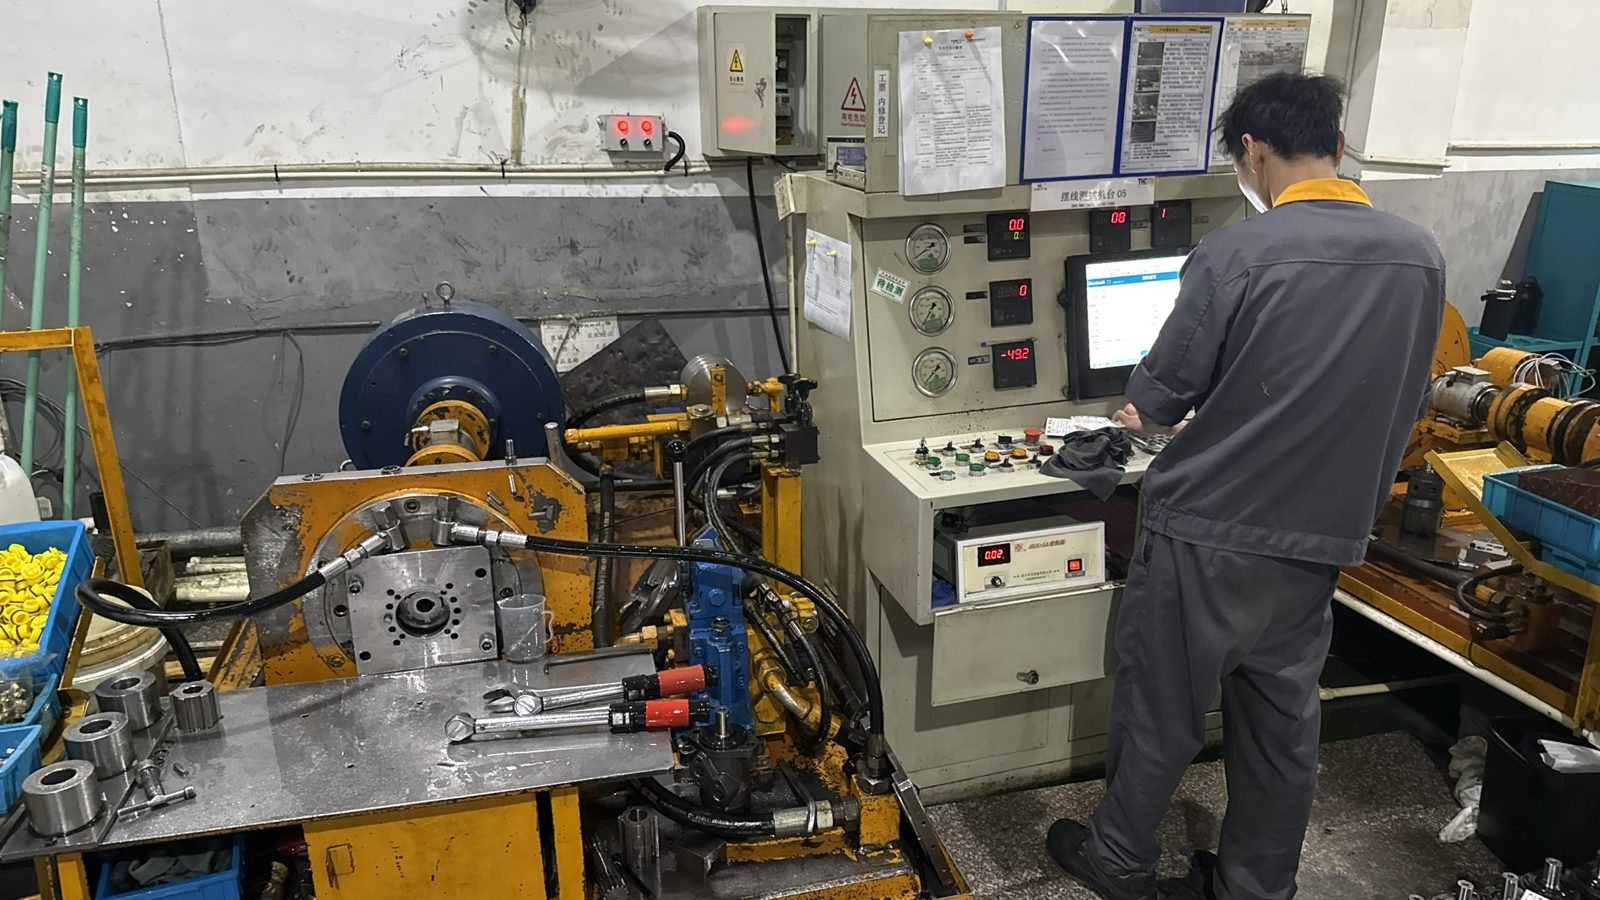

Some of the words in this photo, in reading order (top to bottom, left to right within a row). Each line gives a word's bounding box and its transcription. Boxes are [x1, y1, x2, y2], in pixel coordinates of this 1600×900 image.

[878, 74, 887, 92] 工票
[877, 97, 886, 134] 内修登记
[1060, 188, 1115, 203] 摆线测试机台
[1117, 189, 1127, 199] 05
[876, 278, 904, 297] 待检测
[1019, 284, 1028, 297] 0
